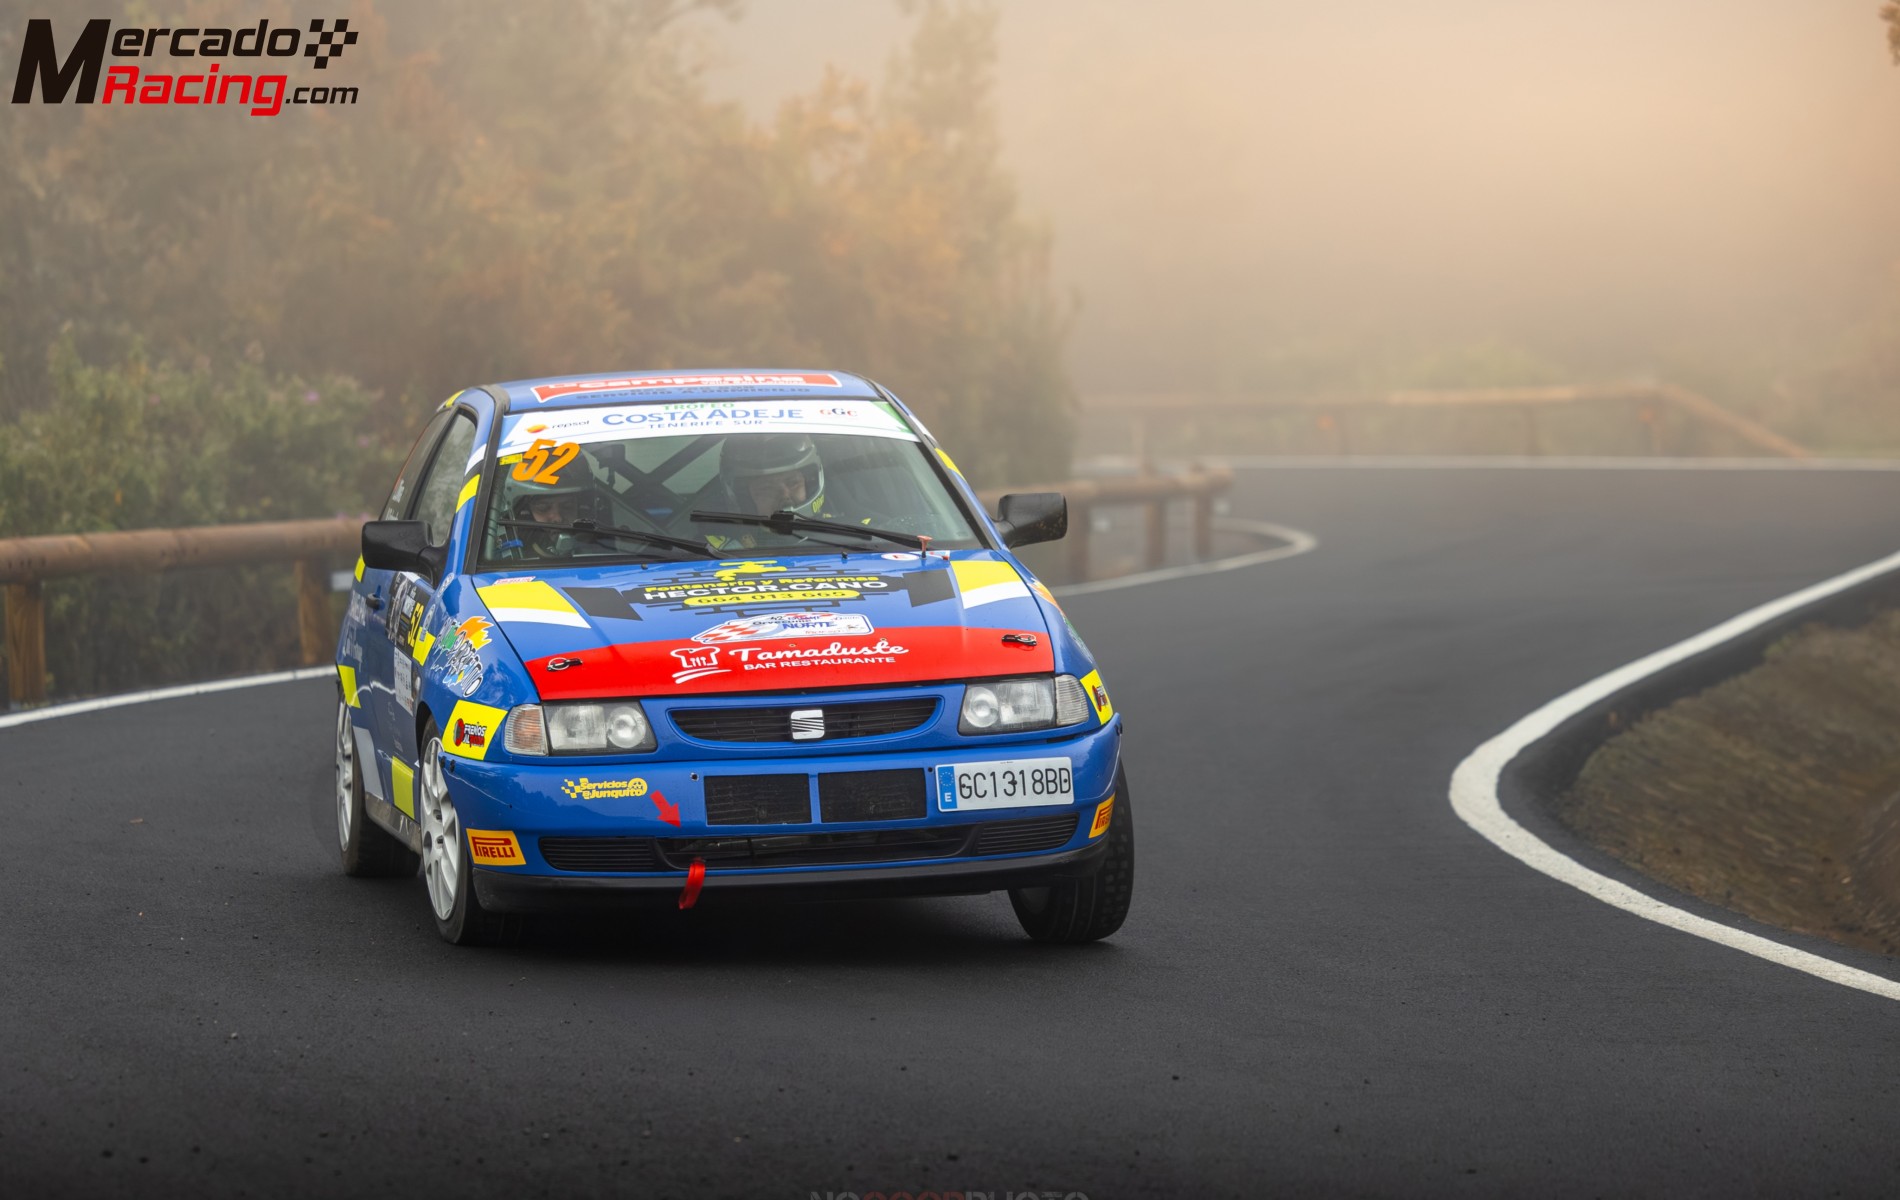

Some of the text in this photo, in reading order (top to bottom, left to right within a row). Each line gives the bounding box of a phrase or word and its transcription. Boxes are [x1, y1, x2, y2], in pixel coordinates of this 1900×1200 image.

[706, 409, 804, 419] ADEJE
[551, 420, 590, 429] repsol
[648, 420, 723, 429] TENERIFE
[511, 438, 580, 485] 52
[643, 581, 889, 600] HECTOR.CANO
[697, 595, 741, 604] 664
[729, 641, 909, 662] Tamaduste
[744, 656, 896, 671] BAR RESTAURANTE
[580, 781, 628, 790] Servicios
[958, 768, 1071, 799] GC1318BD
[944, 792, 953, 802] E
[471, 836, 516, 858] PIRELLI
